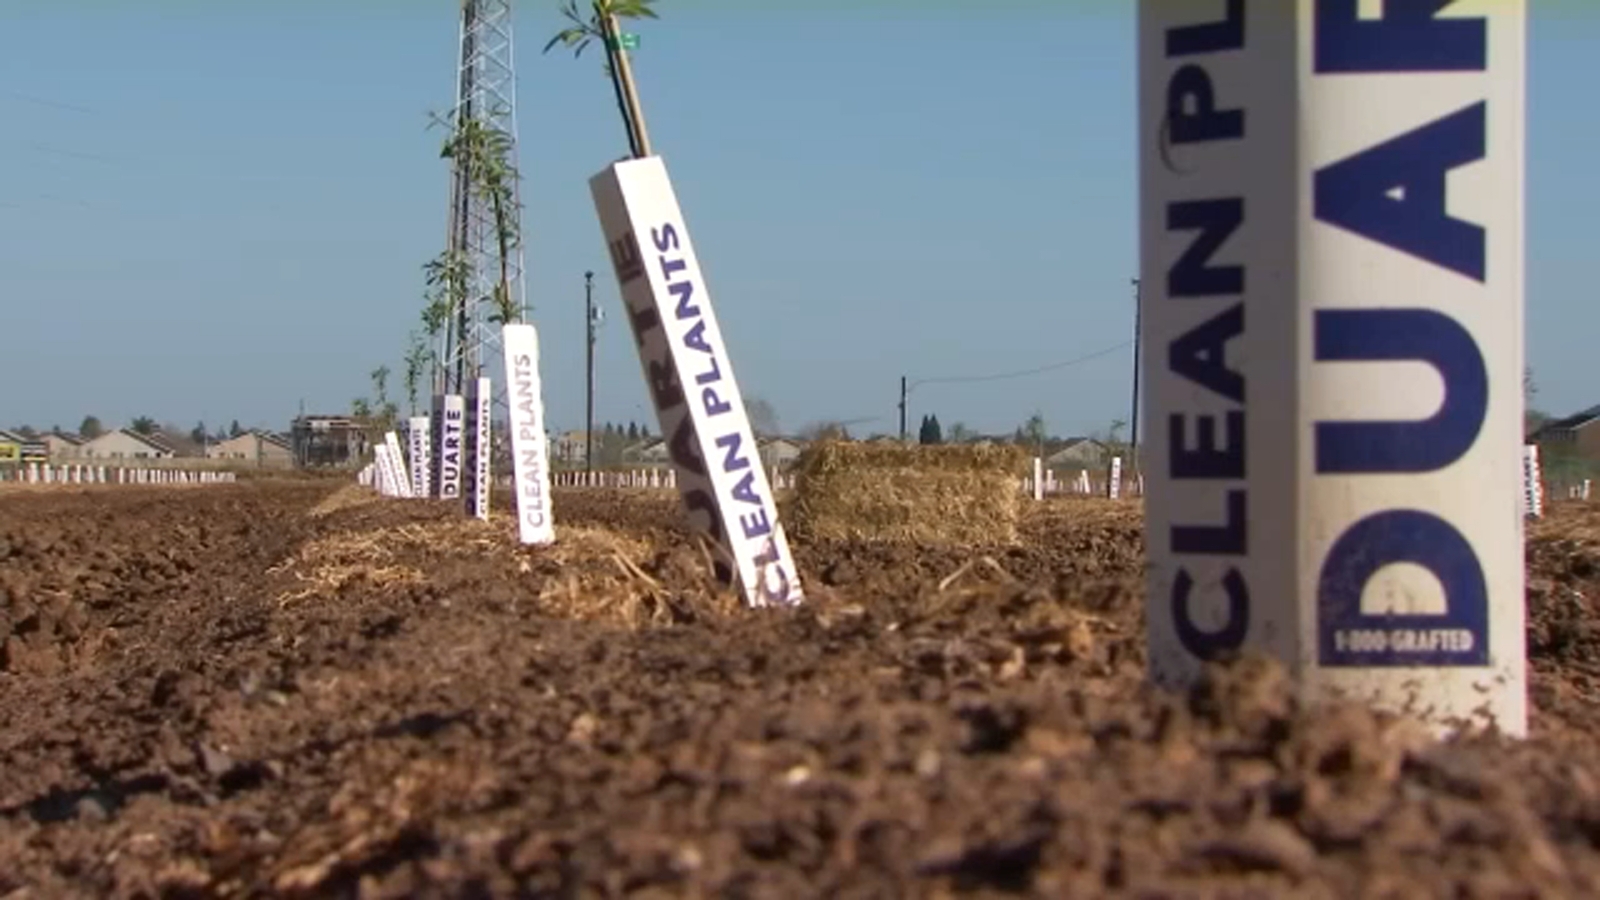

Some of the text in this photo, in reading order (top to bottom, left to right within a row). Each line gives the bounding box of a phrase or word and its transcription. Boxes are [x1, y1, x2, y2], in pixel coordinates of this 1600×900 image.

[444, 410, 460, 496] DUARTE
[514, 354, 545, 528] CLEAN PLANTS
[651, 222, 790, 603] CLEAN PLANTS
[1166, 196, 1250, 663] CLEAN
